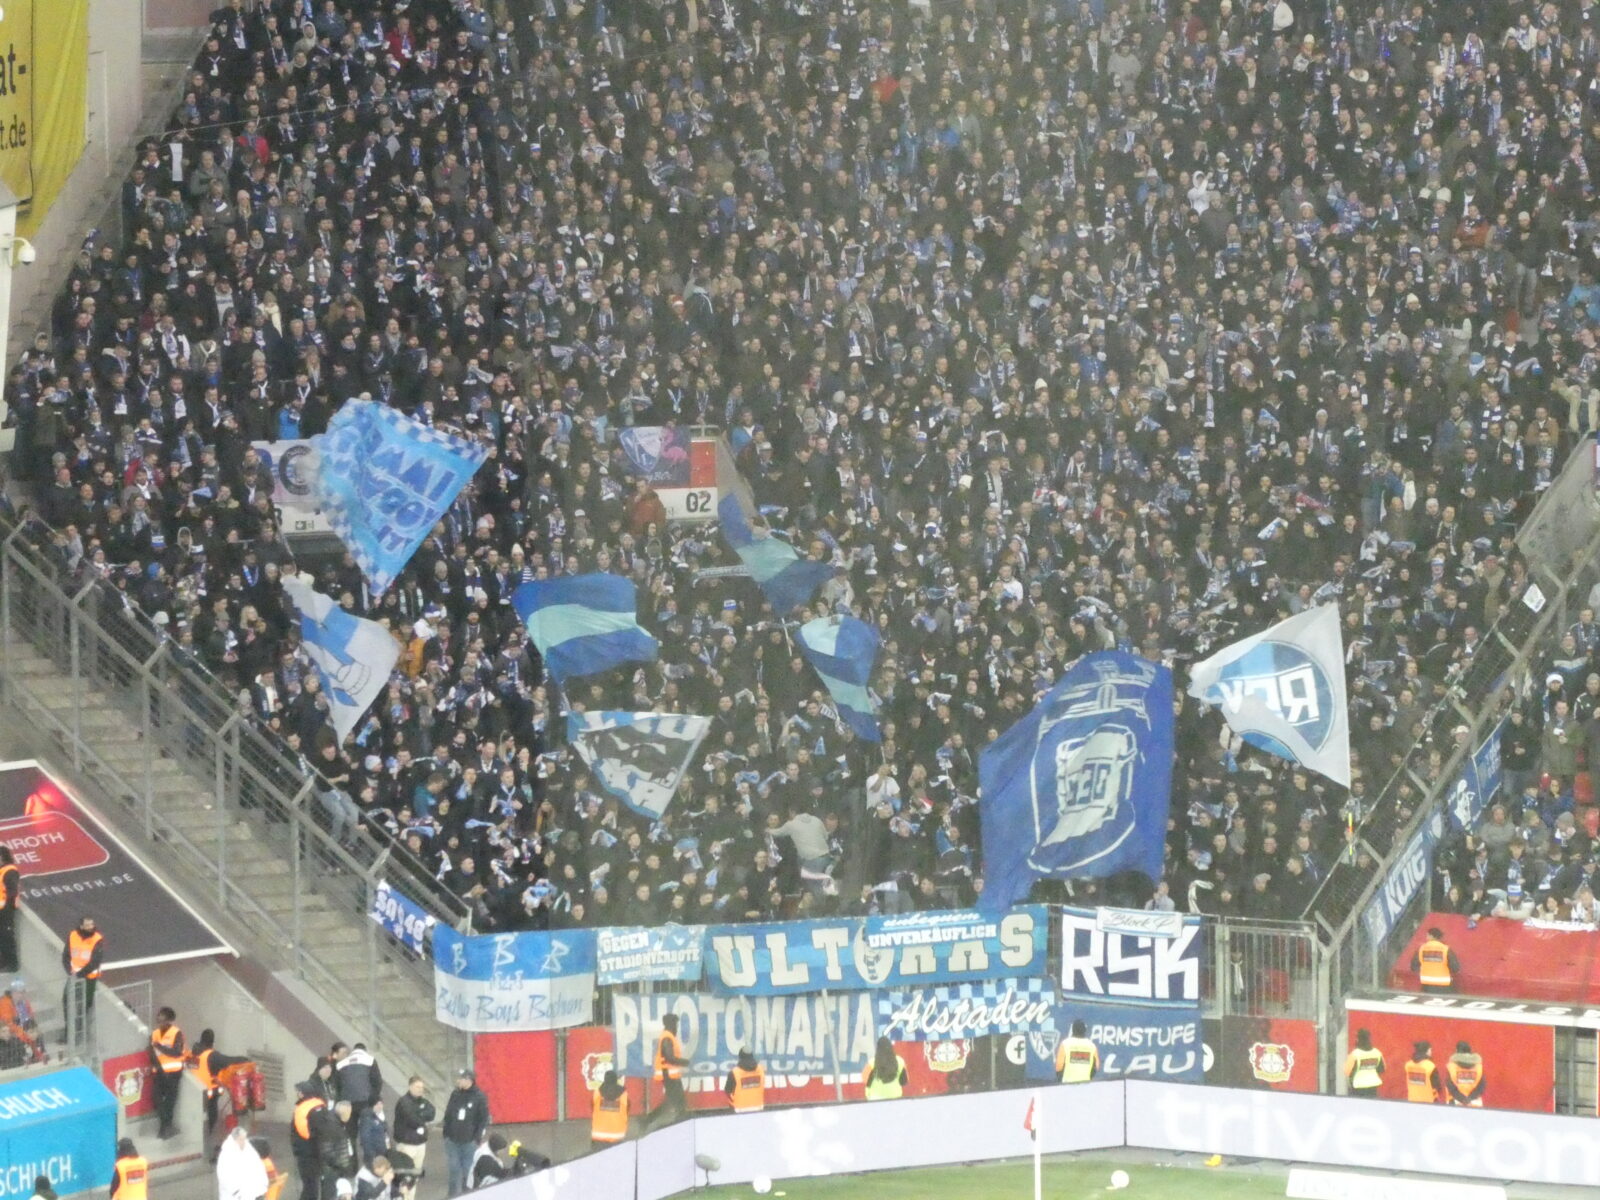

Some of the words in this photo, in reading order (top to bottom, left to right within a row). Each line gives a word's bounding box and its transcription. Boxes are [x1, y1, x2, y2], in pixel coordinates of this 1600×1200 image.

[686, 490, 711, 513] 02
[868, 924, 997, 948] UNVERKÄUFLICH
[1061, 914, 1199, 999] RSK
[613, 990, 876, 1072] PHOTOMAFIA
[884, 987, 1051, 1036] Alstaden
